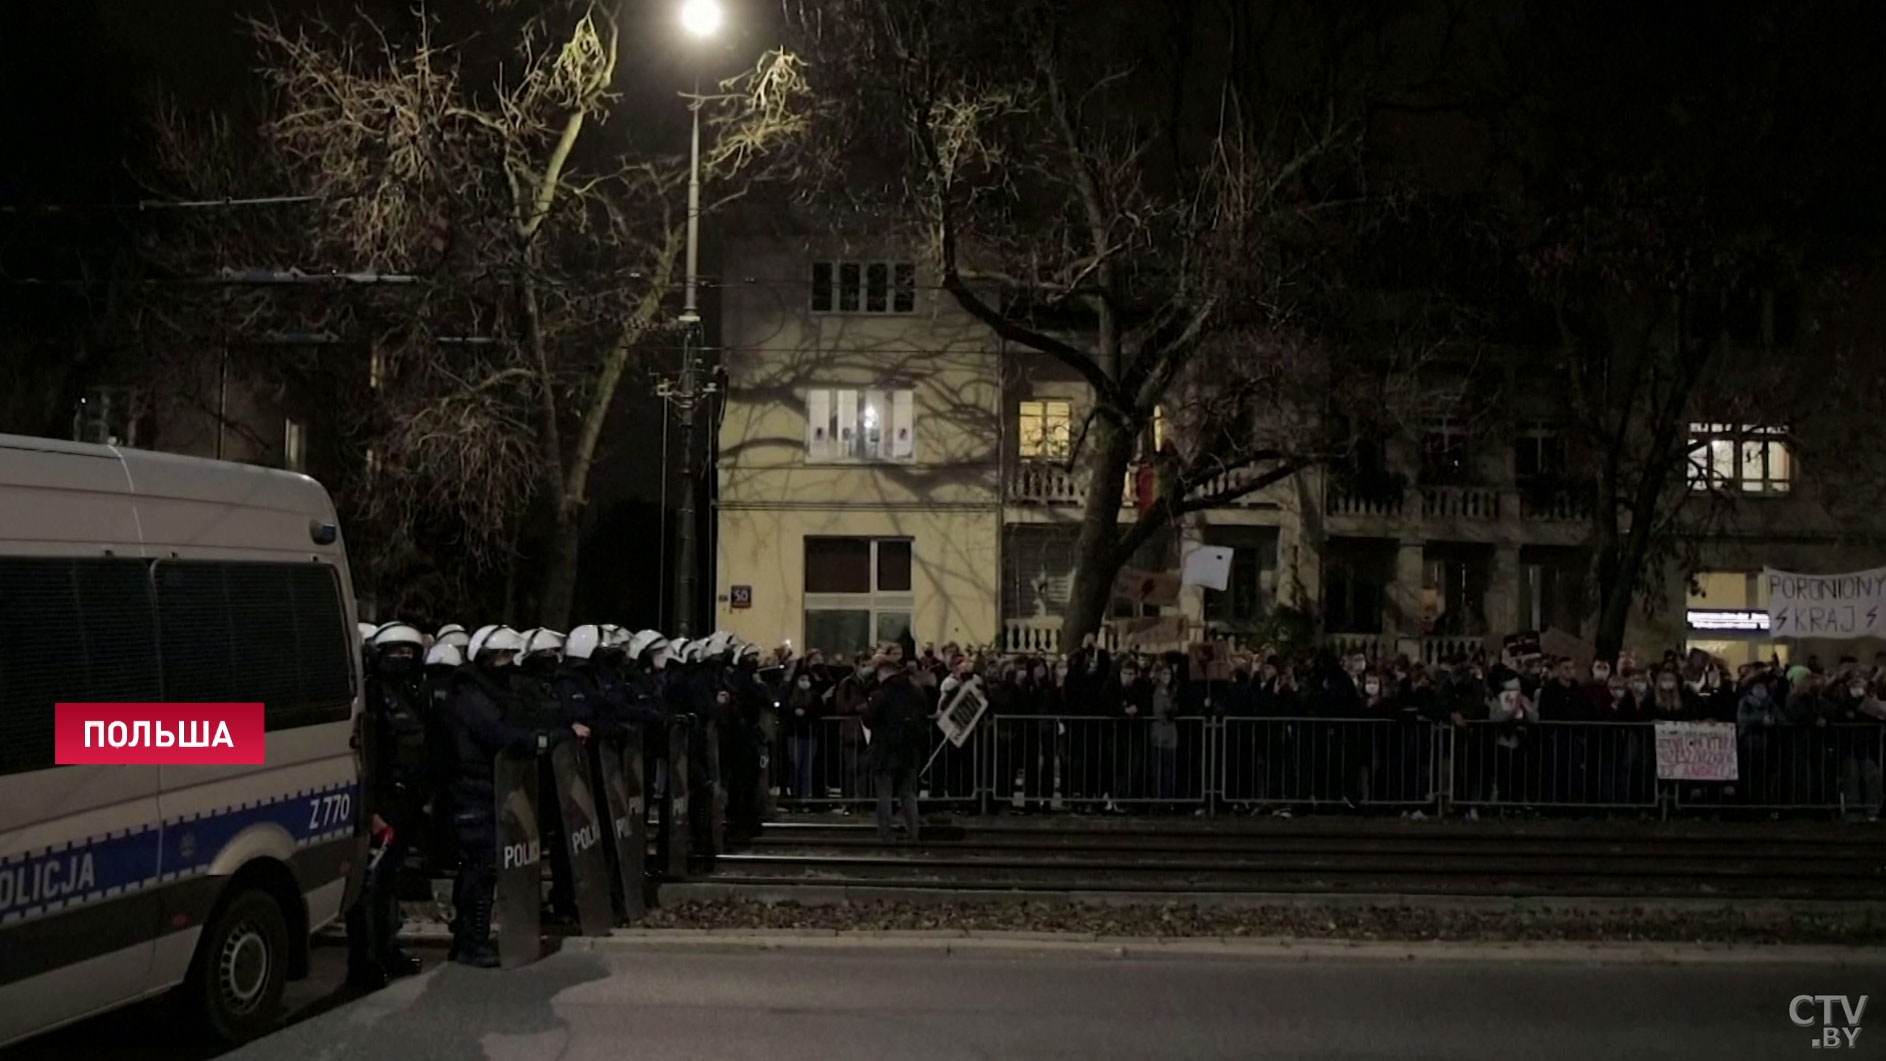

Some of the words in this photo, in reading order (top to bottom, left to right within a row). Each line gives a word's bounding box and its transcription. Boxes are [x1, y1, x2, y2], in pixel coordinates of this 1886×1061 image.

[734, 589, 749, 602] 50
[1769, 575, 1886, 600] PORONIONY
[1795, 605, 1855, 633] KRAJ
[309, 799, 320, 830] Z
[323, 792, 351, 827] 770
